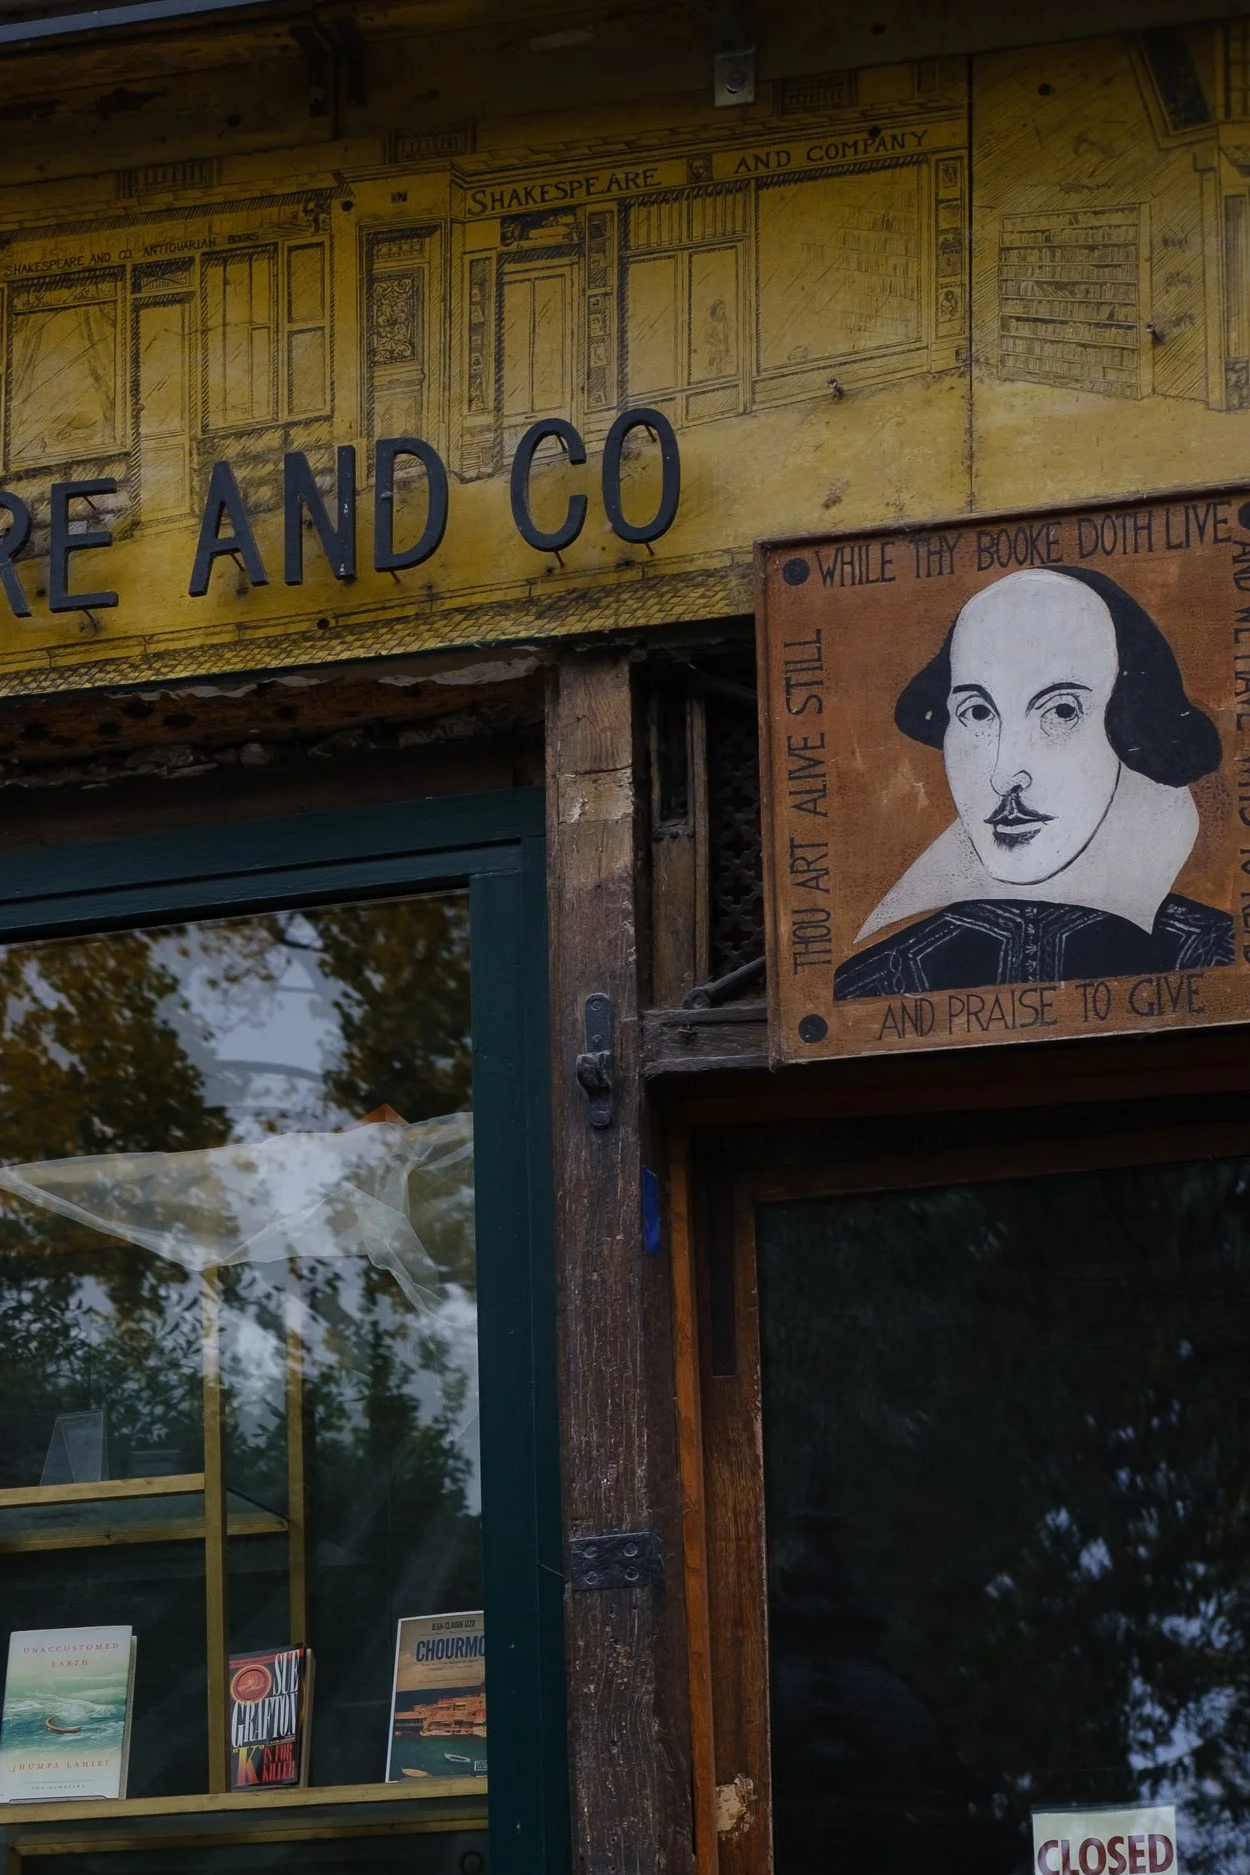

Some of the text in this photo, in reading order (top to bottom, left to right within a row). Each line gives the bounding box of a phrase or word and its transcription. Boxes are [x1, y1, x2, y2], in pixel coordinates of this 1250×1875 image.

[466, 129, 929, 217] SHAKESPEARE AND COMPANY
[4, 256, 83, 278] SHAKESPEARE
[90, 252, 110, 264] AND
[189, 437, 449, 598] AND
[511, 408, 682, 553] CO
[814, 501, 1233, 588] WHILE THY BOOKE DOTH LIVE
[783, 629, 833, 977] THOU ART ALIVE STILL
[878, 972, 1206, 1040] AND PRAISE TO GIVE
[23, 1642, 119, 1654] UNACCUSTOMED
[51, 1659, 89, 1668] EARTH
[273, 1650, 300, 1697] SUE
[231, 1691, 299, 1748] GRAFTON
